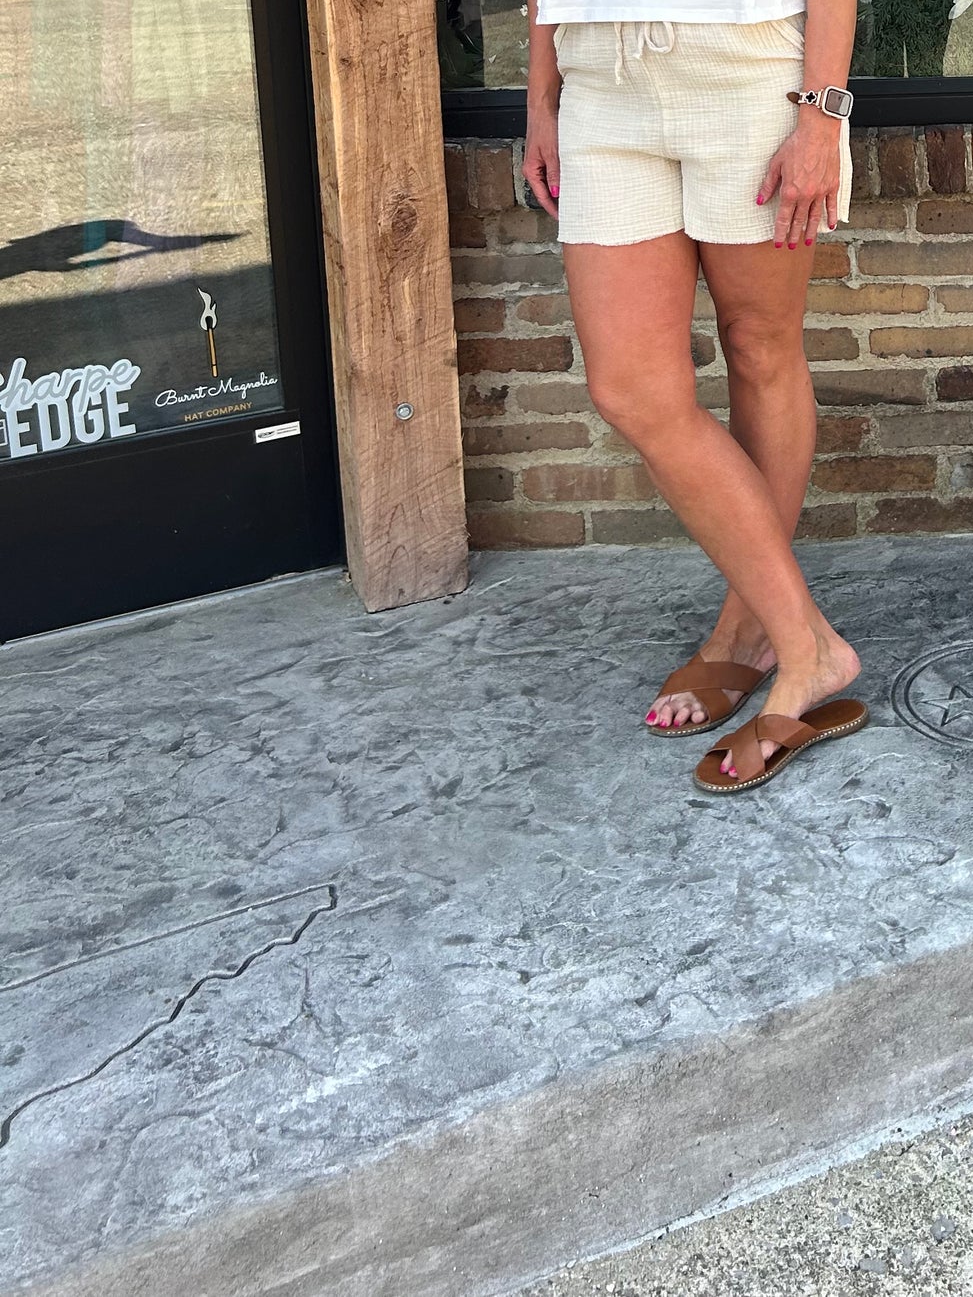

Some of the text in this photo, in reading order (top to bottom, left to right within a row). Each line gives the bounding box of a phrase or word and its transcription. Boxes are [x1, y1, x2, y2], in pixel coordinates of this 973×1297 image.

[0, 357, 141, 415] harpe
[155, 372, 278, 407] Burnt Magnolia
[6, 384, 137, 458] EDGE
[184, 402, 253, 422] HAT COMPANY
